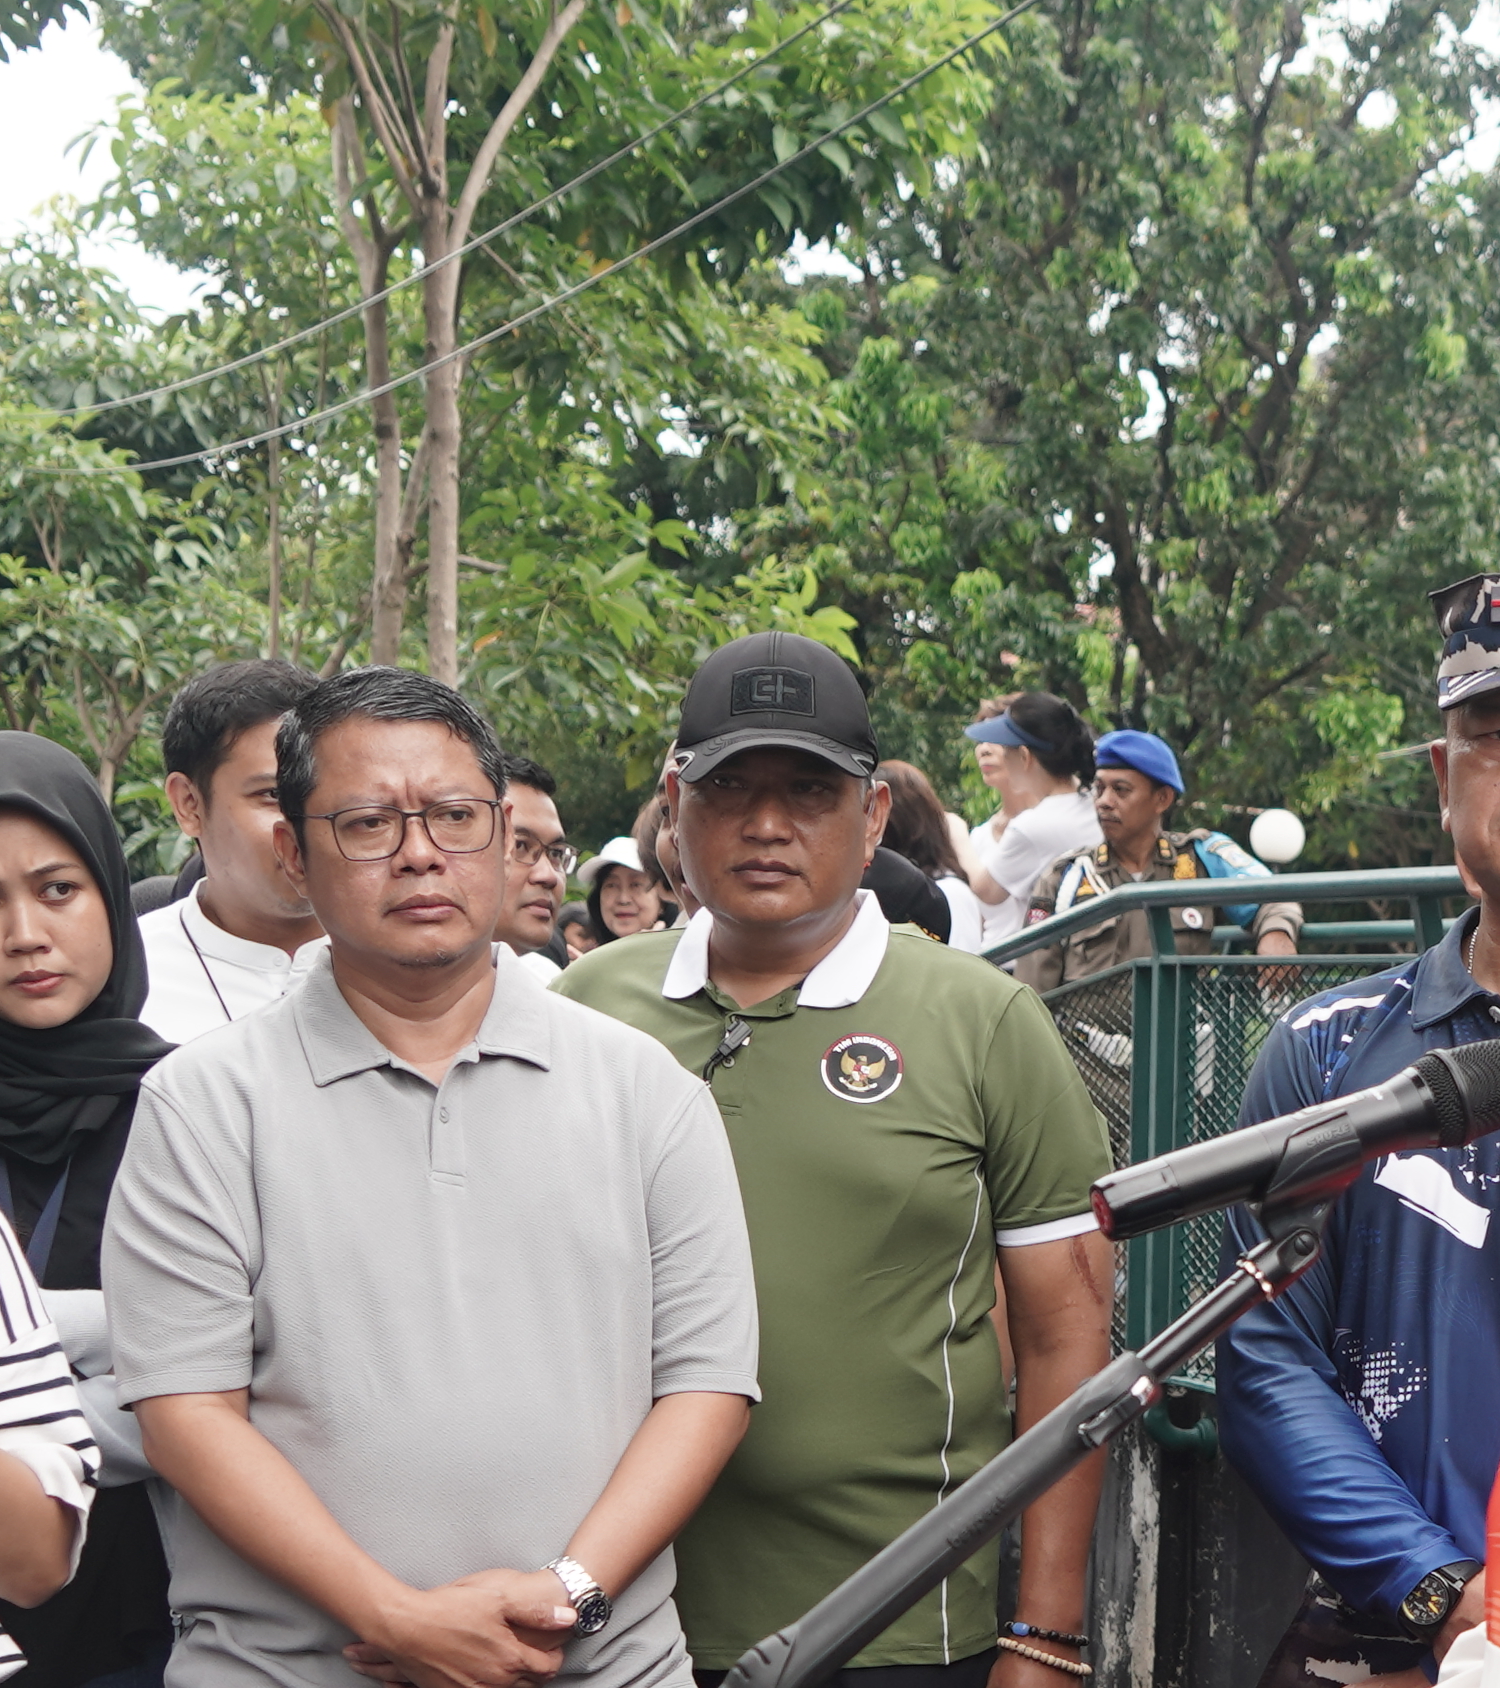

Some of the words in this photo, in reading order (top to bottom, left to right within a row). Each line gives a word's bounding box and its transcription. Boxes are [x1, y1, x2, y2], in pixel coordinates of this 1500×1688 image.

[832, 1038, 853, 1053] TIM
[851, 1035, 898, 1062] INDONESIA
[1306, 1122, 1350, 1147] SHURE
